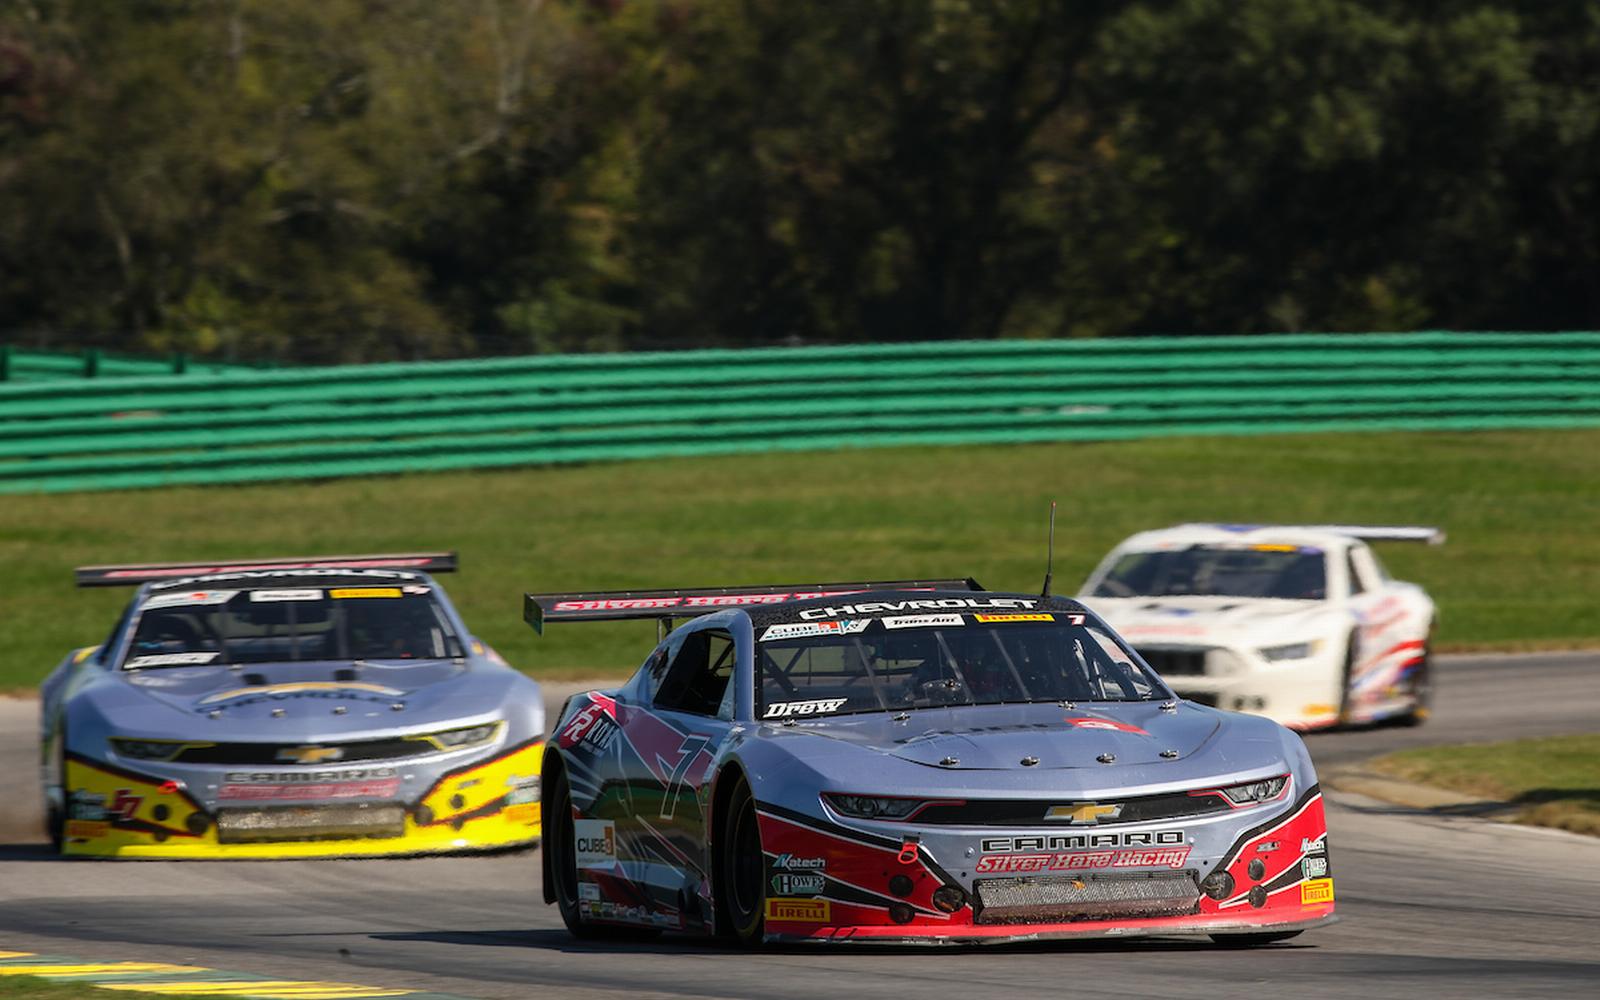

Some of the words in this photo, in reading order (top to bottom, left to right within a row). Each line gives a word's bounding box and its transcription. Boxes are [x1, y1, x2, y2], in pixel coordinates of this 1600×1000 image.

[799, 599, 1037, 620] CHEVROLET
[1067, 614, 1085, 625] 7
[762, 698, 848, 718] Drew
[660, 735, 711, 820] 7
[981, 830, 1185, 853] CAMARO
[777, 853, 826, 871] Katech
[976, 854, 1051, 873] Silver
[1049, 851, 1115, 871] Hare
[1113, 846, 1192, 868] Racing
[770, 901, 825, 919] PIRELLI
